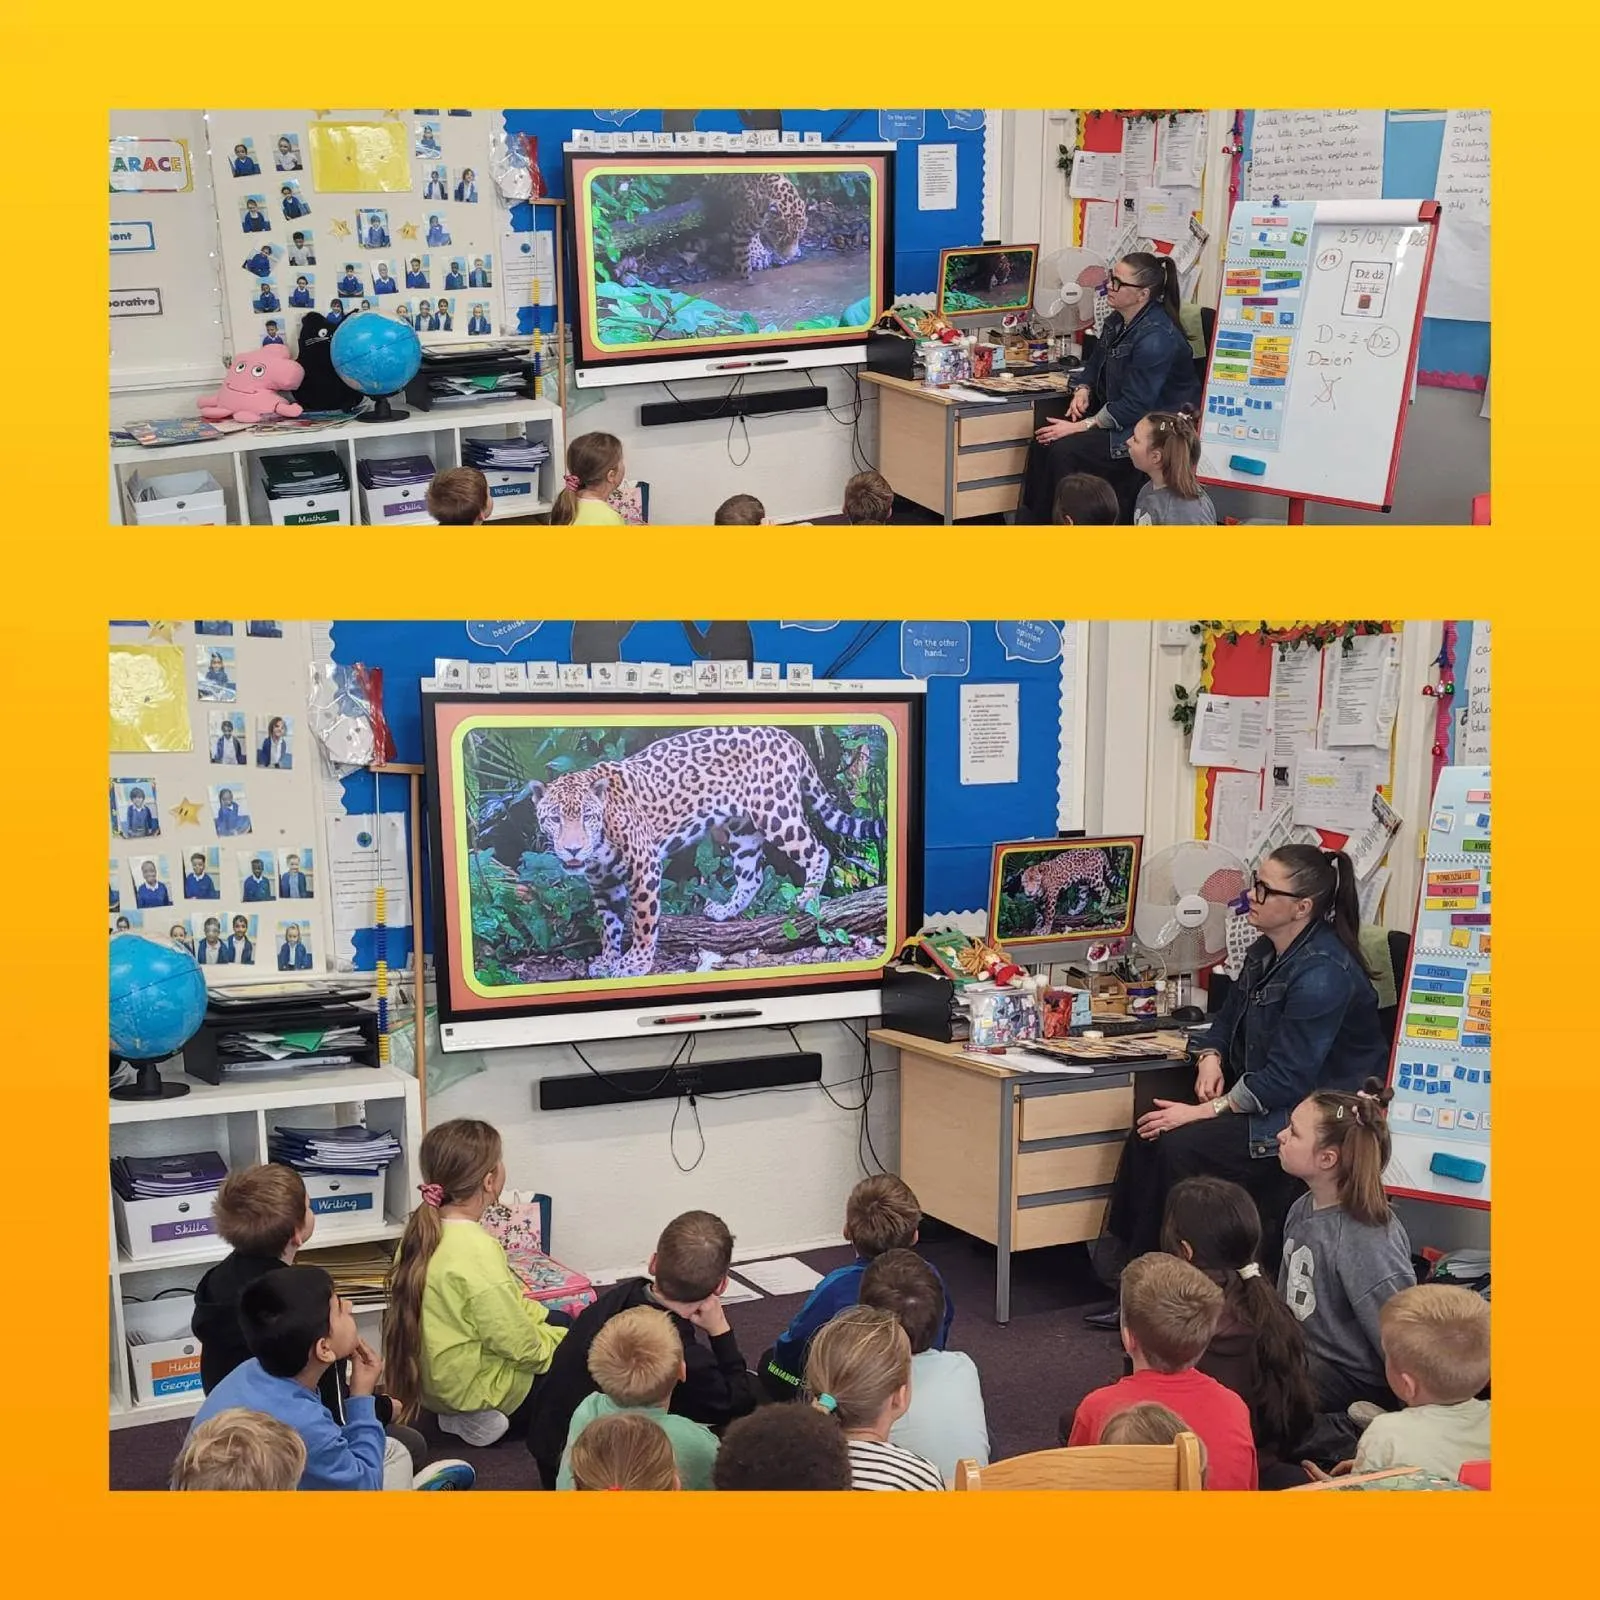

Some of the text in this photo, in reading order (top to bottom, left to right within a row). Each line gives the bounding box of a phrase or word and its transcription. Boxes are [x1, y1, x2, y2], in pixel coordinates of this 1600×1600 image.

[112, 156, 182, 172] ARACE
[1306, 350, 1353, 367] Dzień
[399, 504, 422, 513] Skills
[298, 514, 328, 523] Maths
[913, 637, 959, 648] On the other
[318, 1199, 357, 1210] Writing
[174, 1222, 209, 1235] Skills
